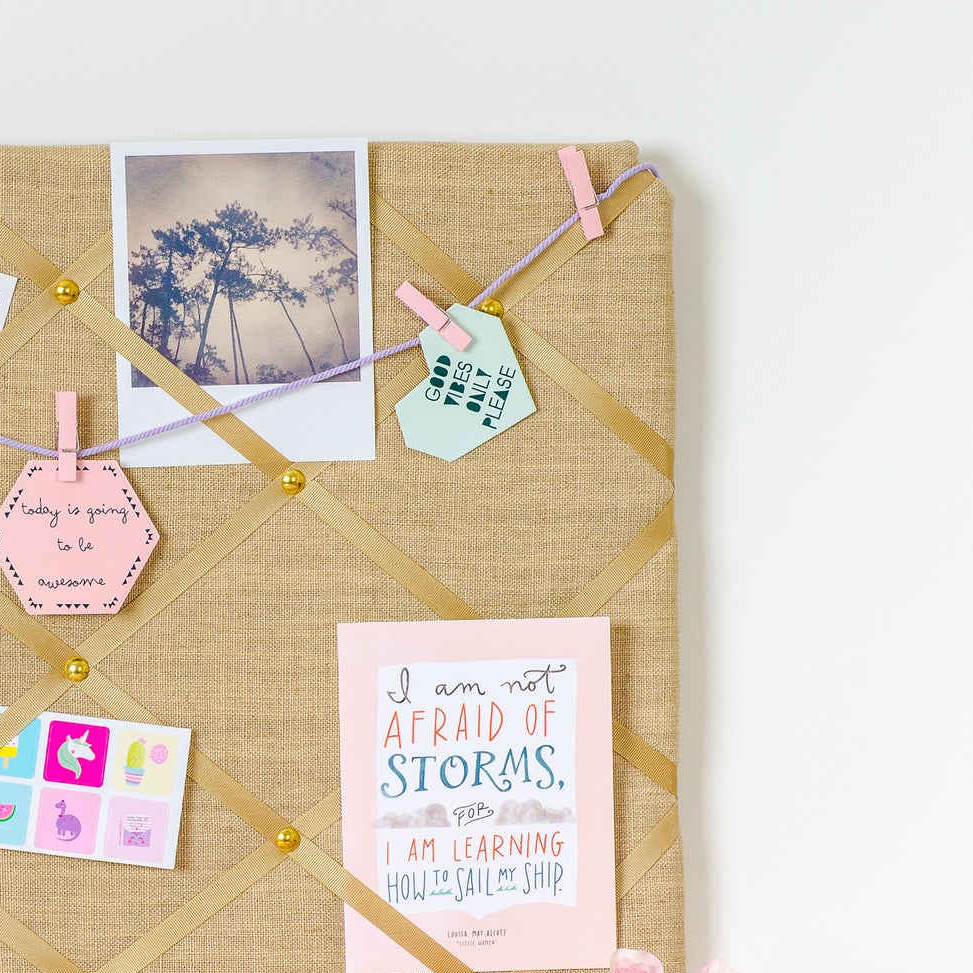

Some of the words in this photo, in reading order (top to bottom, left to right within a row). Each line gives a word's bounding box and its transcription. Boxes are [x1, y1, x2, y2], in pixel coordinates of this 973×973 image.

[425, 355, 451, 402] GOOD
[443, 361, 473, 405] VIBES
[466, 368, 492, 413] ONLY
[482, 365, 516, 430] PLEASE
[21, 497, 61, 528] today
[67, 503, 81, 516] is
[86, 504, 129, 524] going
[57, 538, 73, 552] to
[78, 537, 94, 552] be
[38, 577, 106, 589] awesome
[387, 667, 412, 704] I
[435, 682, 486, 696] am
[500, 664, 567, 694] not
[383, 700, 504, 749] AFRAID
[525, 700, 556, 738] OF
[380, 744, 565, 799] STORMS,
[455, 802, 492, 827] FOR
[385, 840, 391, 865] I
[408, 837, 435, 863] AM
[453, 830, 564, 863] LEARNING
[387, 870, 427, 904] HOW
[433, 869, 449, 886] TO
[455, 867, 494, 902] SAIL
[498, 867, 517, 884] MY
[523, 861, 564, 897] SHIP.
